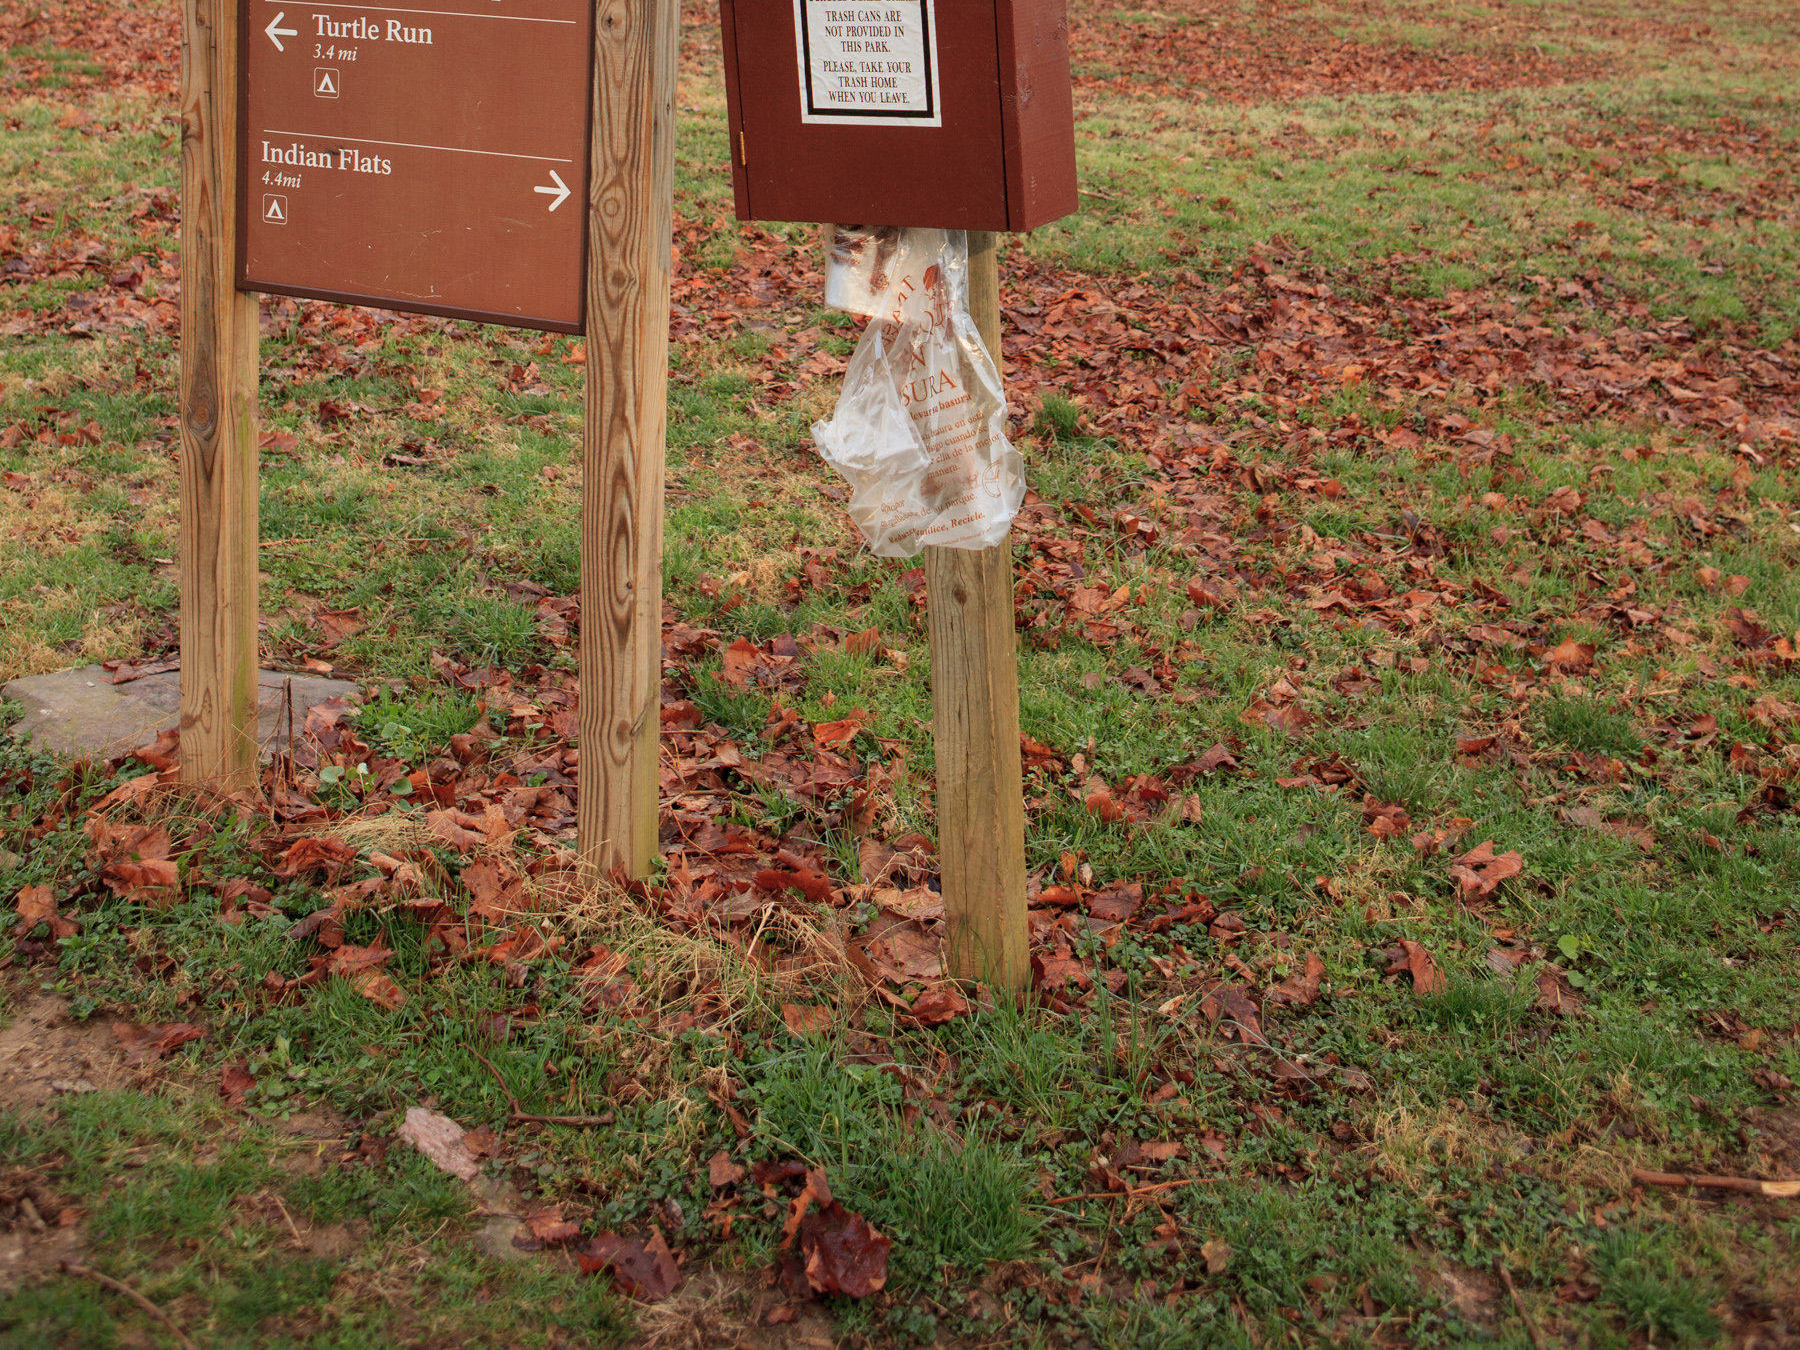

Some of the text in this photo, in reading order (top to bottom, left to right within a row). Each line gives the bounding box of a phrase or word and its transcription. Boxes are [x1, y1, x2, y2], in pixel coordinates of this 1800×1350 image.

[825, 10, 902, 22] TRASH CANS ARE
[312, 14, 433, 44] Turtle Run
[825, 26, 905, 37] NOT PROVIDED IN
[312, 44, 358, 61] 3.4 mi
[841, 41, 891, 53] THIS PARK.
[823, 61, 912, 74] PLEASE, TAKE YOUR
[838, 76, 898, 88] TRASH HOME
[829, 91, 910, 104] WHEN YOU LEAVE.
[262, 140, 392, 175] Indian Flats
[903, 370, 957, 407] SURA
[939, 394, 972, 410] basura
[945, 429, 977, 446] cuando
[950, 511, 986, 528] Recicle.
